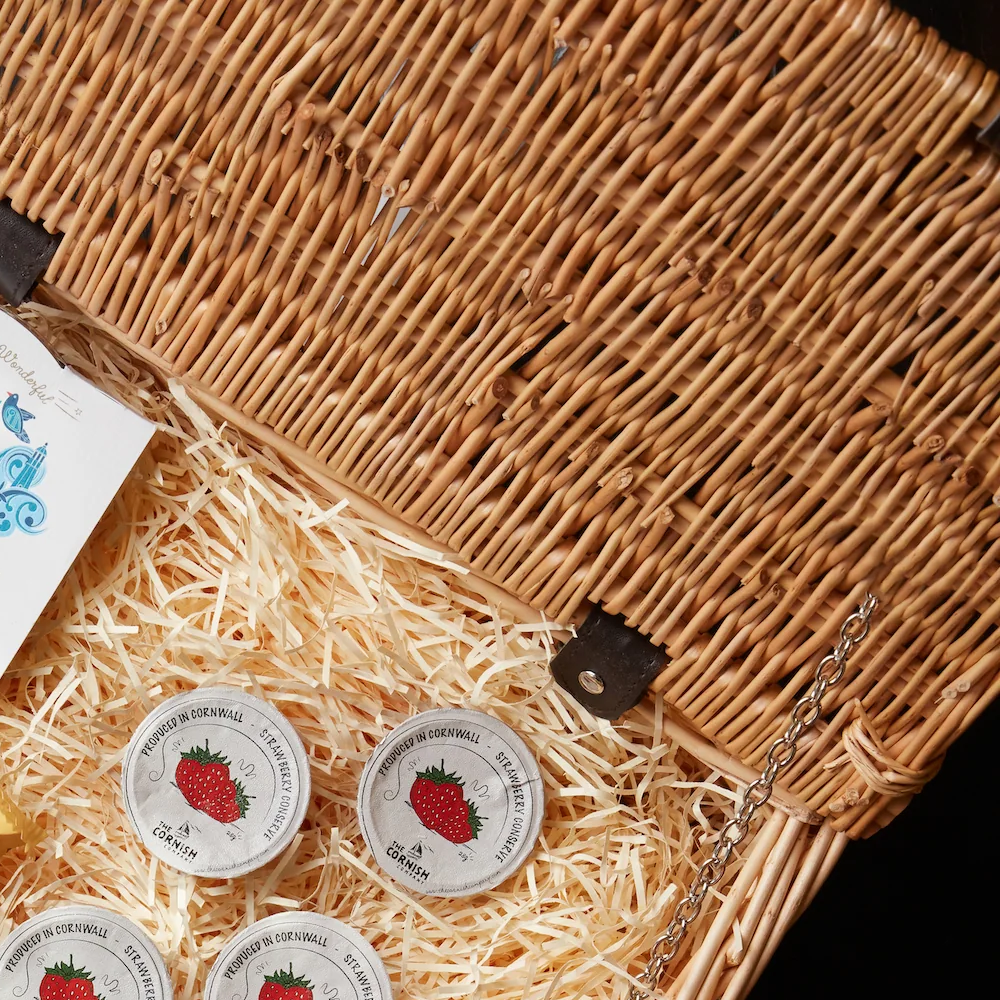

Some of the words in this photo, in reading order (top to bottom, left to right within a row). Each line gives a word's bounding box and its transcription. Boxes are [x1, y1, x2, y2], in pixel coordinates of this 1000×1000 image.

[0, 344, 54, 404] Wonderful
[178, 712, 190, 724] IN
[191, 708, 243, 723] CORNWALL
[142, 718, 177, 756] PRODUCED
[416, 732, 426, 744] IN
[428, 728, 480, 744] CORNWALL
[260, 729, 292, 793] STRAWBERRY
[378, 738, 414, 776] PRODUCED
[495, 751, 525, 816] STRAWBERRY
[158, 820, 172, 833] THE
[263, 795, 290, 842] CONSERVE
[152, 826, 198, 860] CORNISH
[164, 844, 192, 864] COMPANY
[392, 840, 405, 853] THE
[495, 818, 522, 864] CONSERVE
[386, 846, 430, 880] CORNISH
[396, 864, 425, 884] COMPANY
[6, 932, 41, 972] PRODUCED
[42, 926, 54, 939] IN
[56, 924, 108, 939] CORNWALL
[224, 941, 260, 980] PRODUCED
[262, 934, 274, 946] IN
[276, 932, 328, 948] CORNWALL
